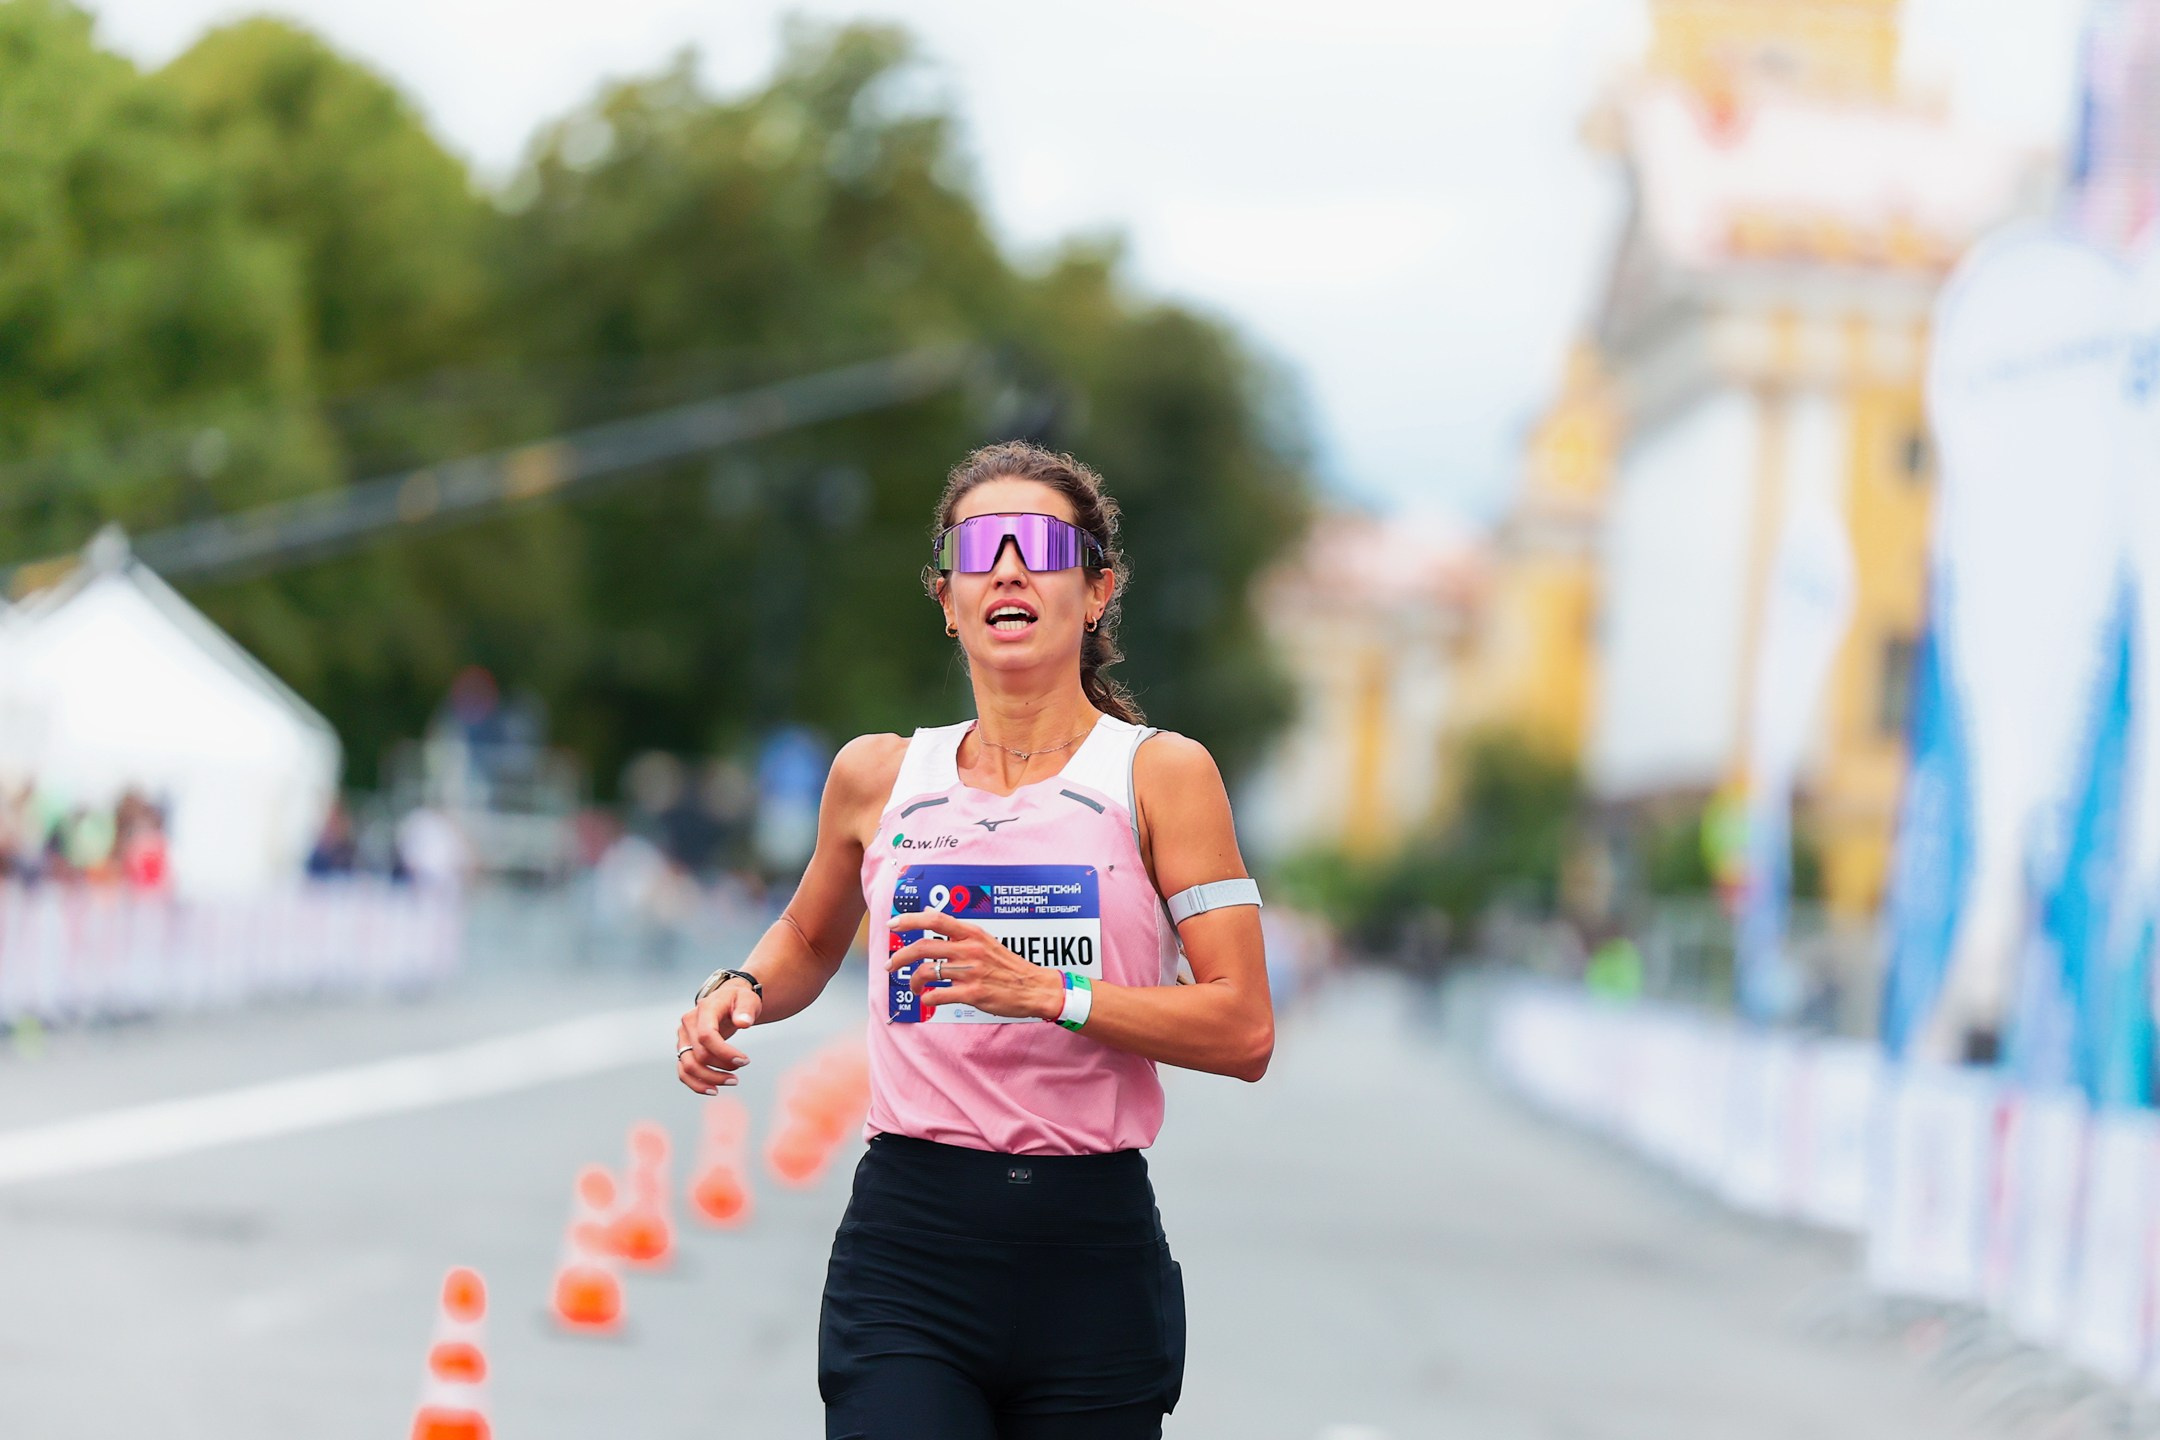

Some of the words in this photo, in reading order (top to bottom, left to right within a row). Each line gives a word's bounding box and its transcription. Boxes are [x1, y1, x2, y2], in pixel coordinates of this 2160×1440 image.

[993, 882, 1082, 895] ПЕТЕРБУРГСКИЙ
[993, 895, 1049, 905] МАРАФОН
[994, 906, 1029, 914] ПУШКИН
[1035, 905, 1082, 914] ПЕТЕРБУРГ
[895, 990, 914, 1003] 30
